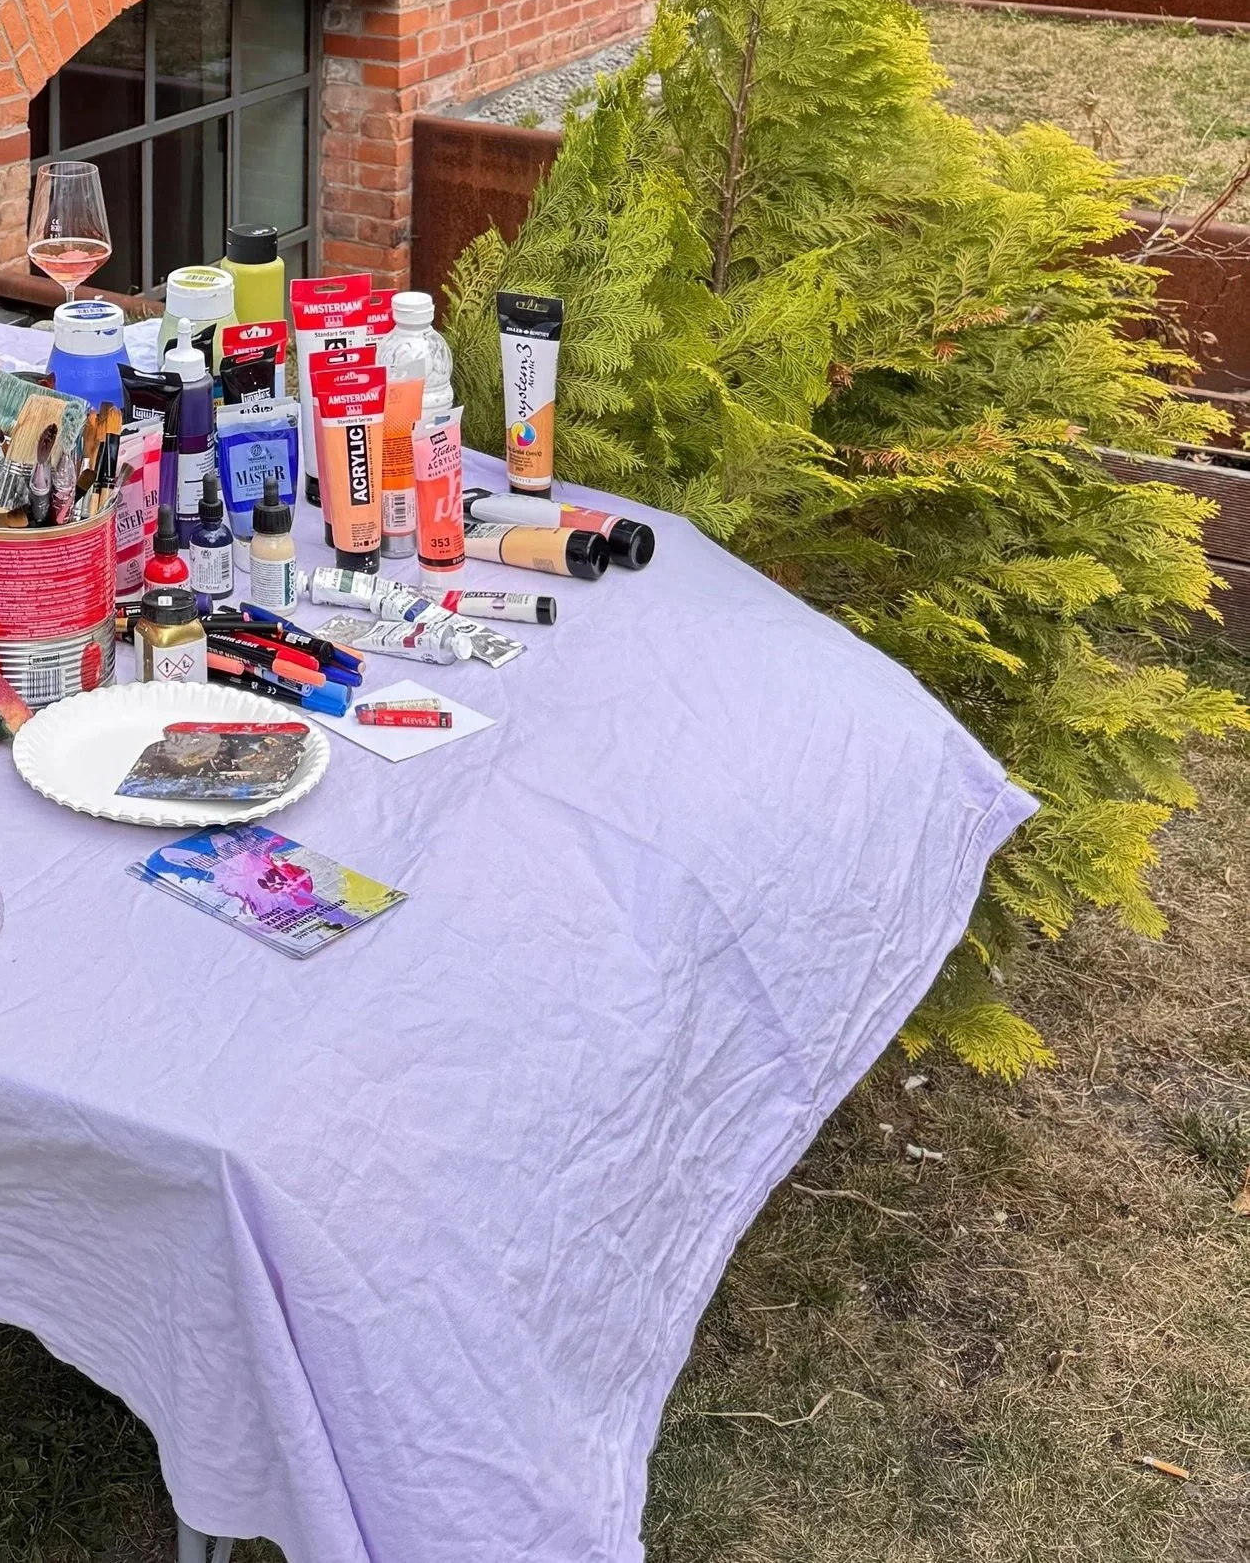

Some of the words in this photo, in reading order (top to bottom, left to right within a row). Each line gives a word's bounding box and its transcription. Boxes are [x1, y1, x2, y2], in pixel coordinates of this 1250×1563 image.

[303, 301, 362, 315] AMSTERDAM
[339, 329, 355, 337] Series
[328, 390, 380, 405] AMSTERDAM
[337, 417, 358, 425] Standard
[359, 416, 373, 424] Series
[431, 444, 456, 462] Studio
[350, 426, 368, 502] ACRYLIC
[235, 465, 286, 487] MASTER
[116, 509, 144, 534] ASTER
[430, 538, 450, 548] 353
[257, 906, 284, 922] KUNST
[264, 908, 297, 926] KARTEN
[272, 902, 324, 930] WORKSHOPS
[281, 914, 317, 934] OFFENES
[316, 899, 349, 917] ATELIER
